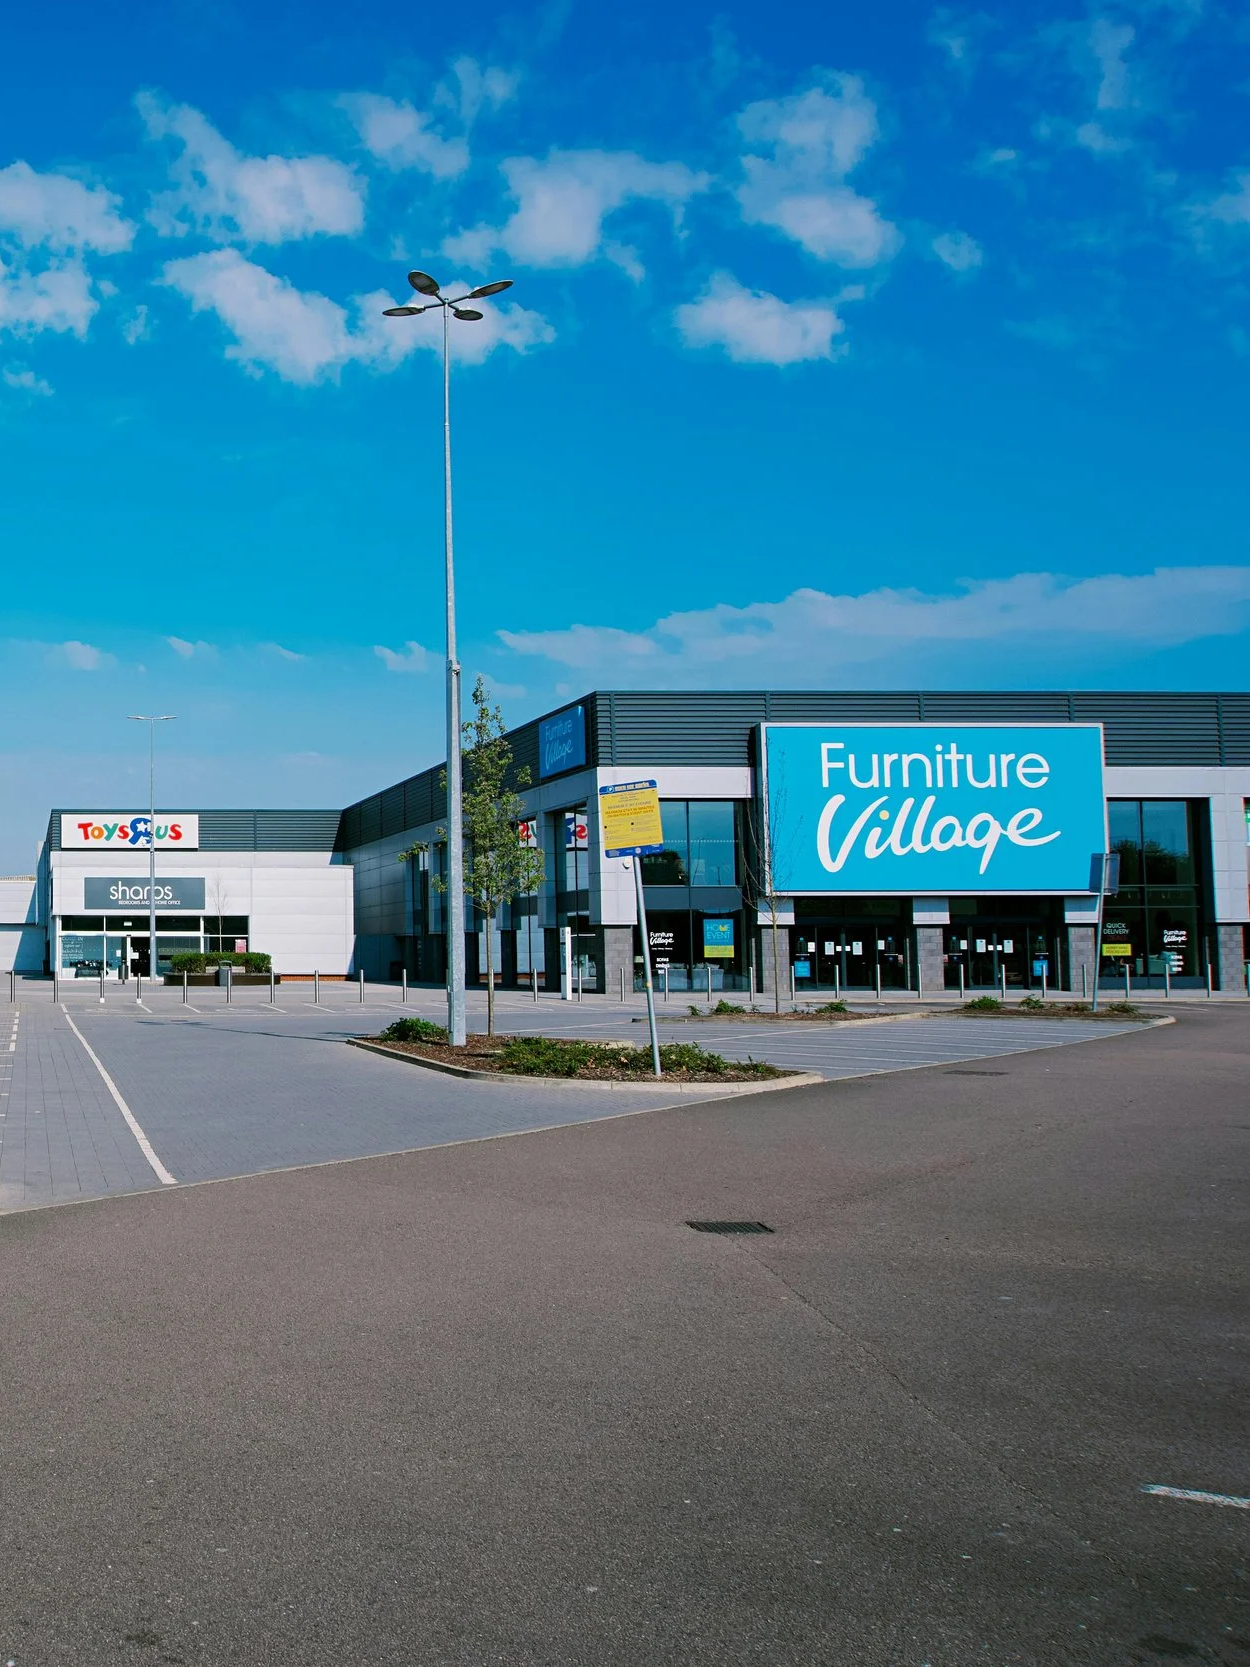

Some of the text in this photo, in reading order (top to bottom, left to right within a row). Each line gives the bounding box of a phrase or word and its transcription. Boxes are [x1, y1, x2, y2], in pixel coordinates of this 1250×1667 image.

[545, 719, 573, 742] Furniture
[545, 739, 574, 770] Village
[820, 742, 1050, 789] Furniture
[816, 794, 1062, 875] Village
[650, 937, 674, 946] Village
